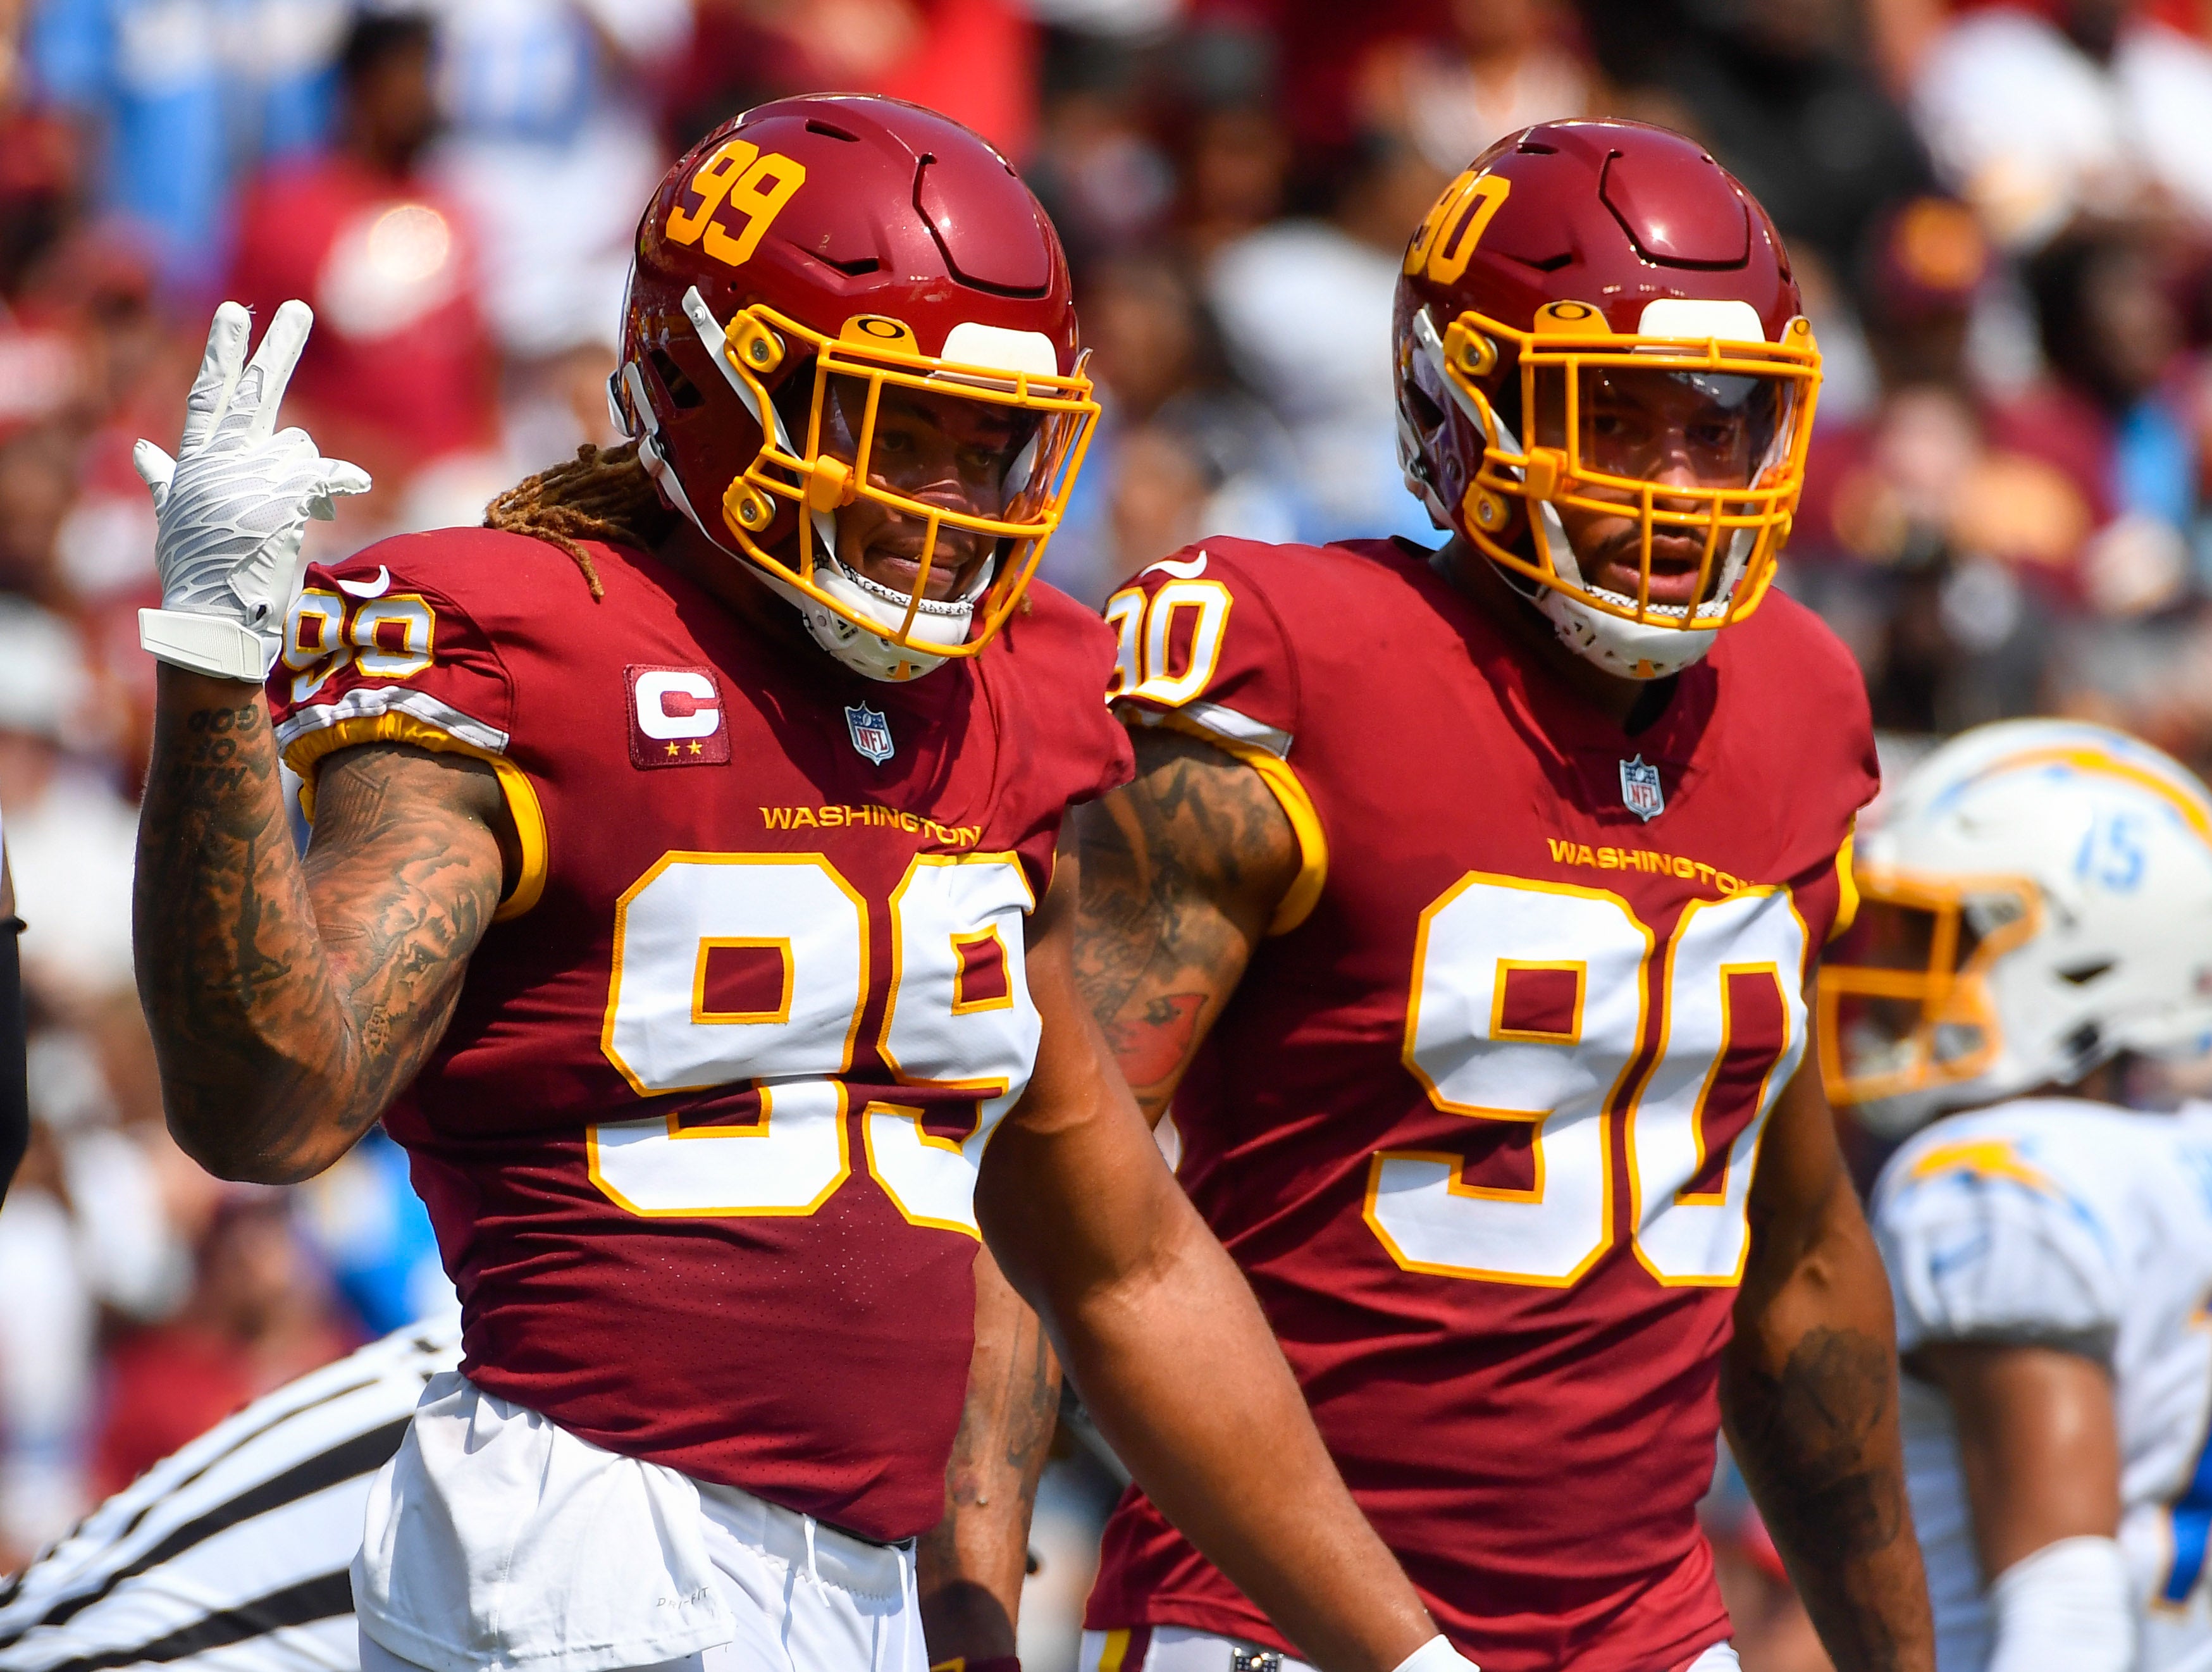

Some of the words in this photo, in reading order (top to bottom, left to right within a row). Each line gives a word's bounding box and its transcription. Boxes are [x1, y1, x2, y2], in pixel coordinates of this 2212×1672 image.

[665, 139, 806, 267] 99
[1402, 170, 1512, 285] 90
[187, 704, 259, 733] GOD
[635, 671, 720, 740] C
[857, 728, 888, 753] NFL
[1631, 784, 1657, 808] NFL
[758, 804, 981, 847] WASHINGTON
[1547, 838, 1755, 895] WASHINGTO
[586, 850, 1042, 1242] 99
[1362, 870, 1809, 1288] 90
[656, 1587, 709, 1609] DRI-FIT
